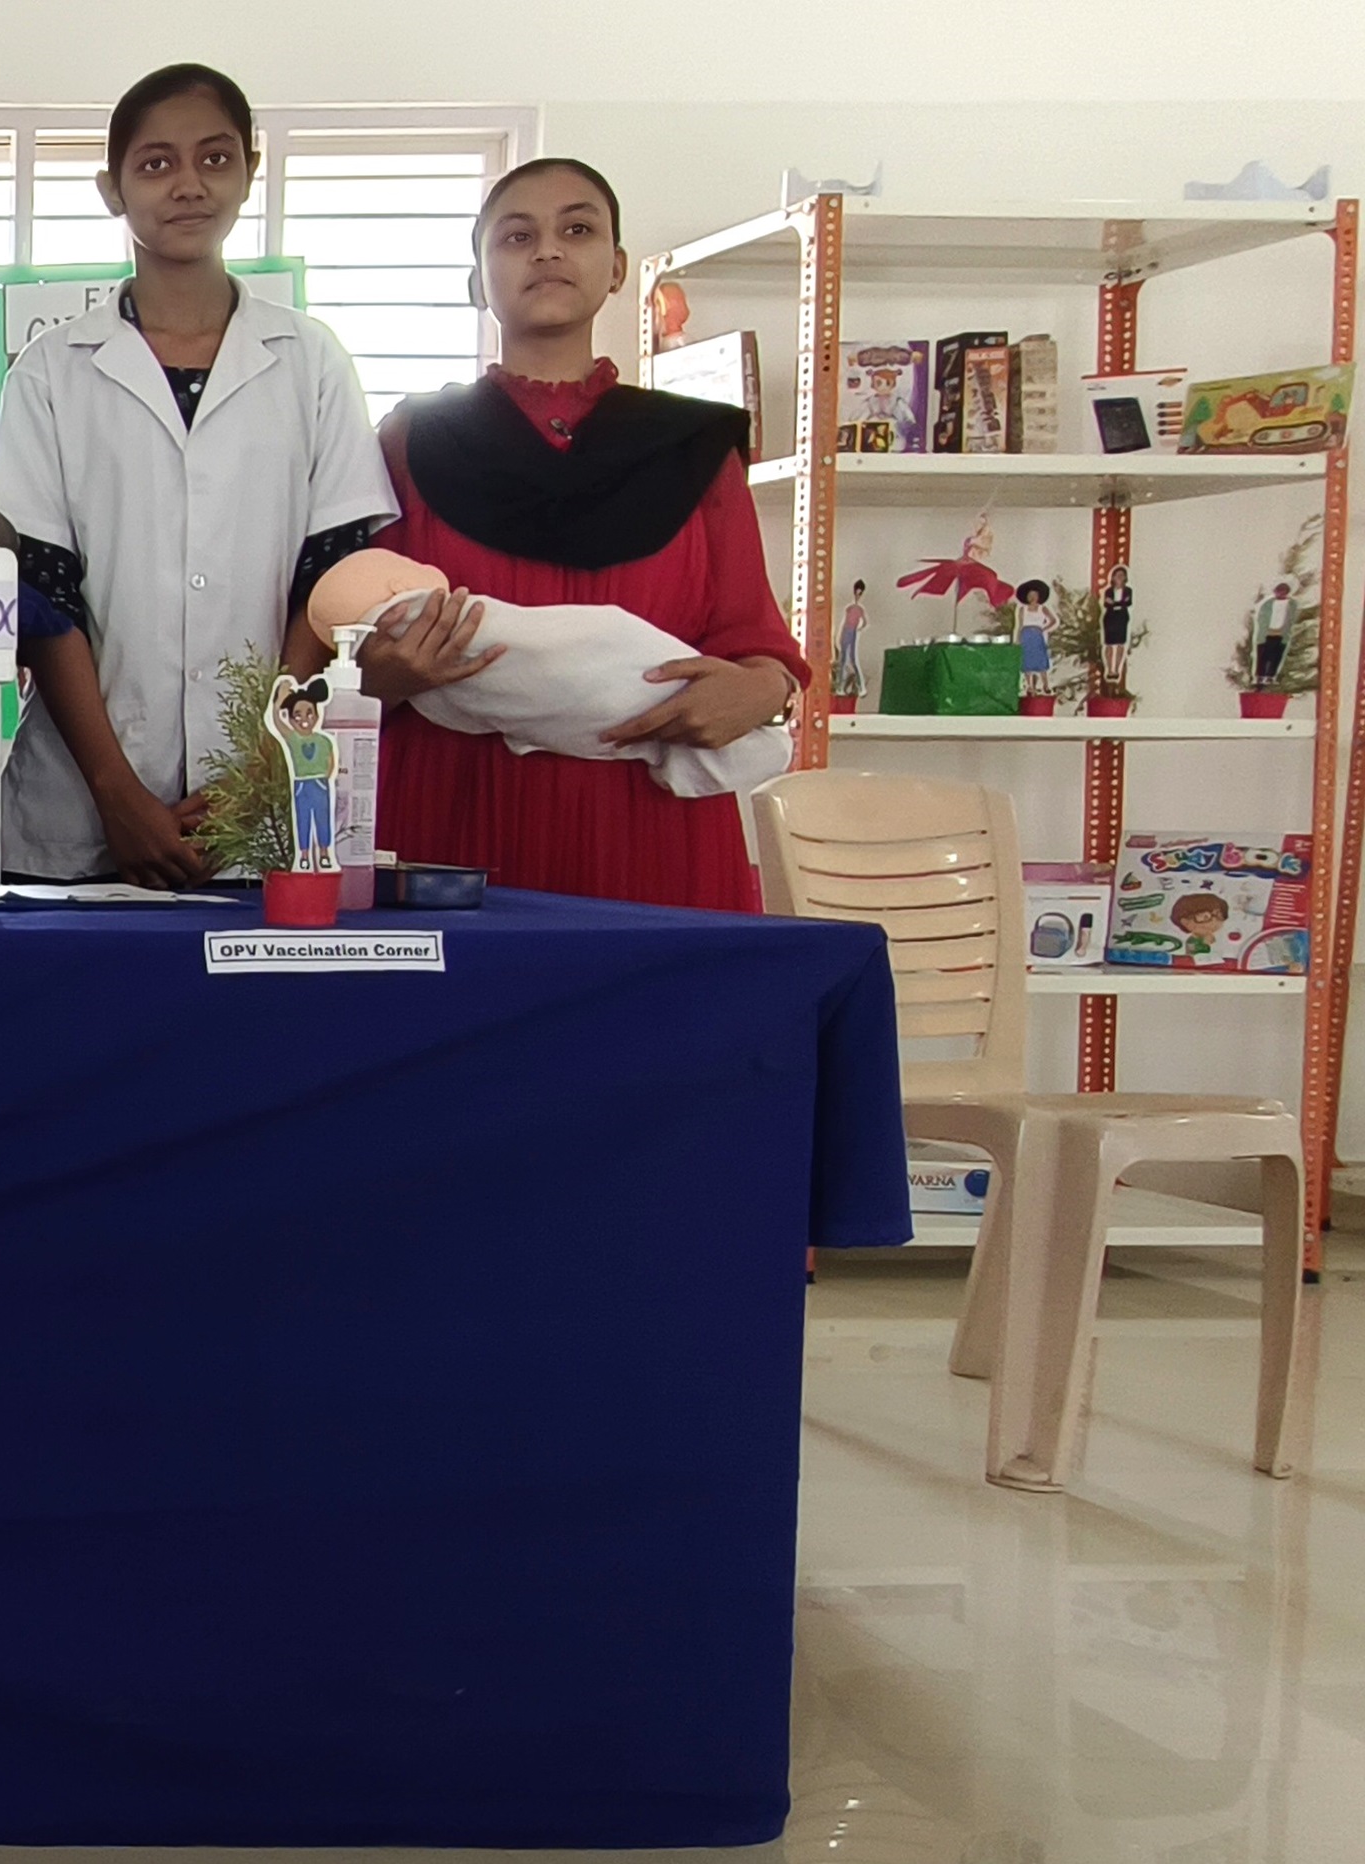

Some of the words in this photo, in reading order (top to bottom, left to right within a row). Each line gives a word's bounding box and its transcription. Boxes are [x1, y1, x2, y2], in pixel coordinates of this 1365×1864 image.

[220, 944, 258, 957] OPV
[263, 943, 369, 957] Vaccination
[373, 943, 431, 957] Corner
